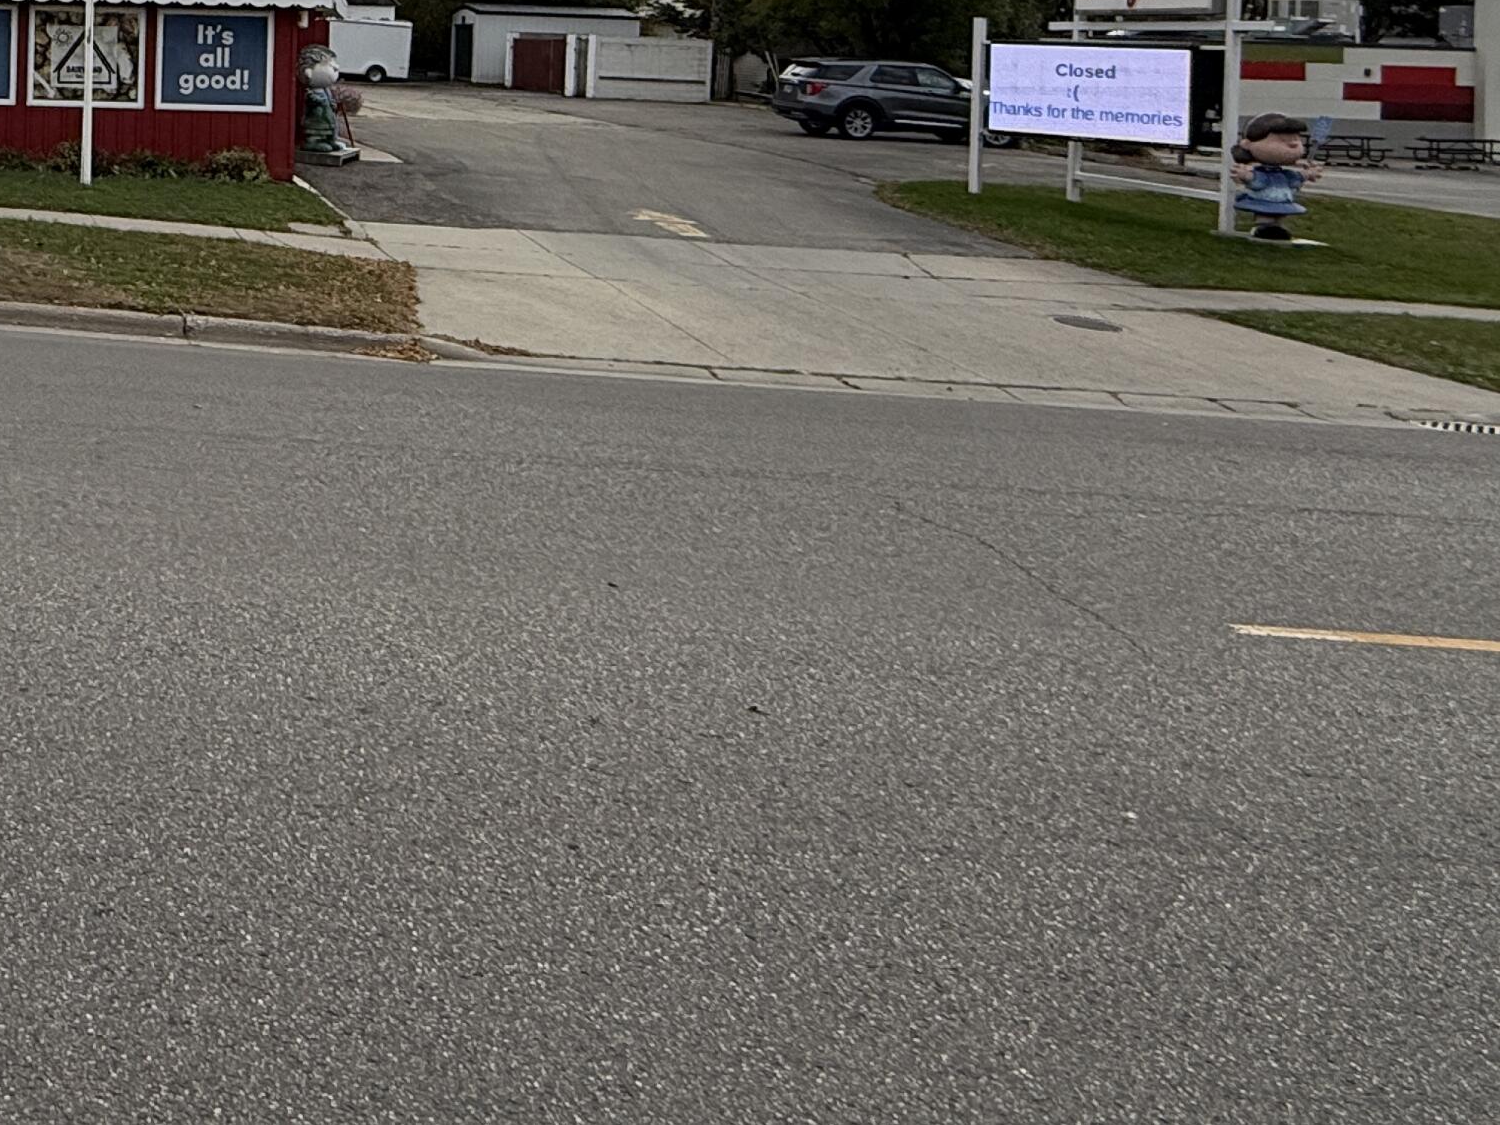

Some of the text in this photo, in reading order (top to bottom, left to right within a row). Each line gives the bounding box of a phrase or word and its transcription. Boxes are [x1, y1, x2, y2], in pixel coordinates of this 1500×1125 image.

[197, 24, 234, 46] It's
[199, 46, 230, 68] all
[179, 69, 250, 95] good!
[1055, 63, 1117, 80] Closed
[991, 101, 1183, 126] Thanks for the memories
